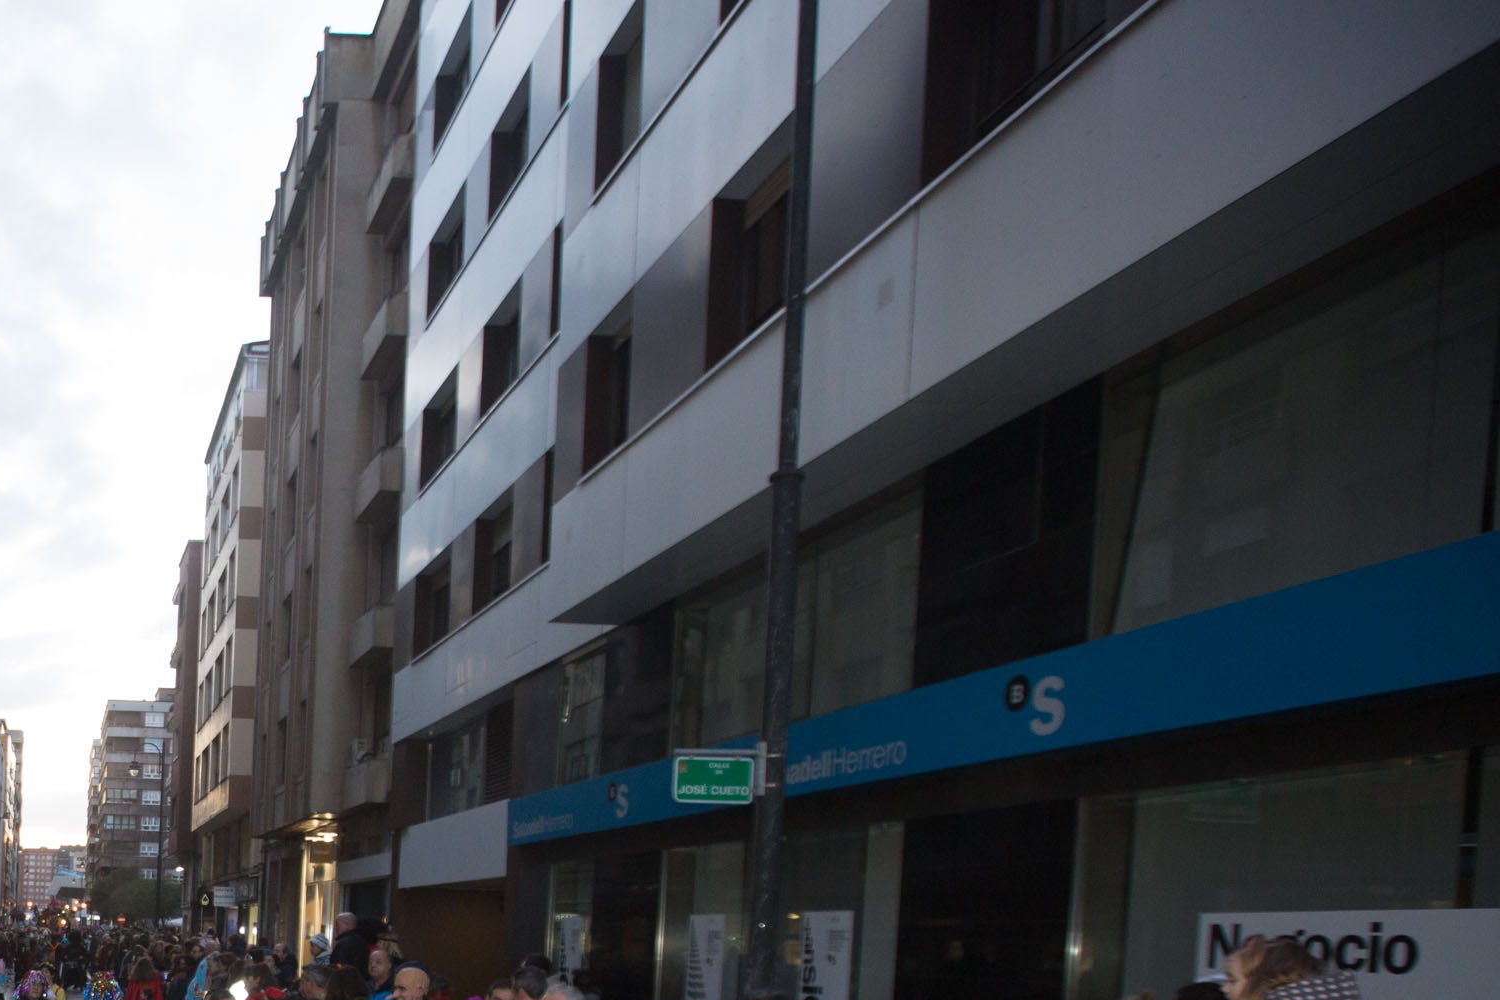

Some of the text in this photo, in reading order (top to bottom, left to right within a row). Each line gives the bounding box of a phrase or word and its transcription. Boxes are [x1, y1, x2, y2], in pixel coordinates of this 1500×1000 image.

[786, 741, 907, 784] adellHerrero
[677, 783, 749, 796] JOSÉ CUETO
[1207, 922, 1419, 975] Nocio
